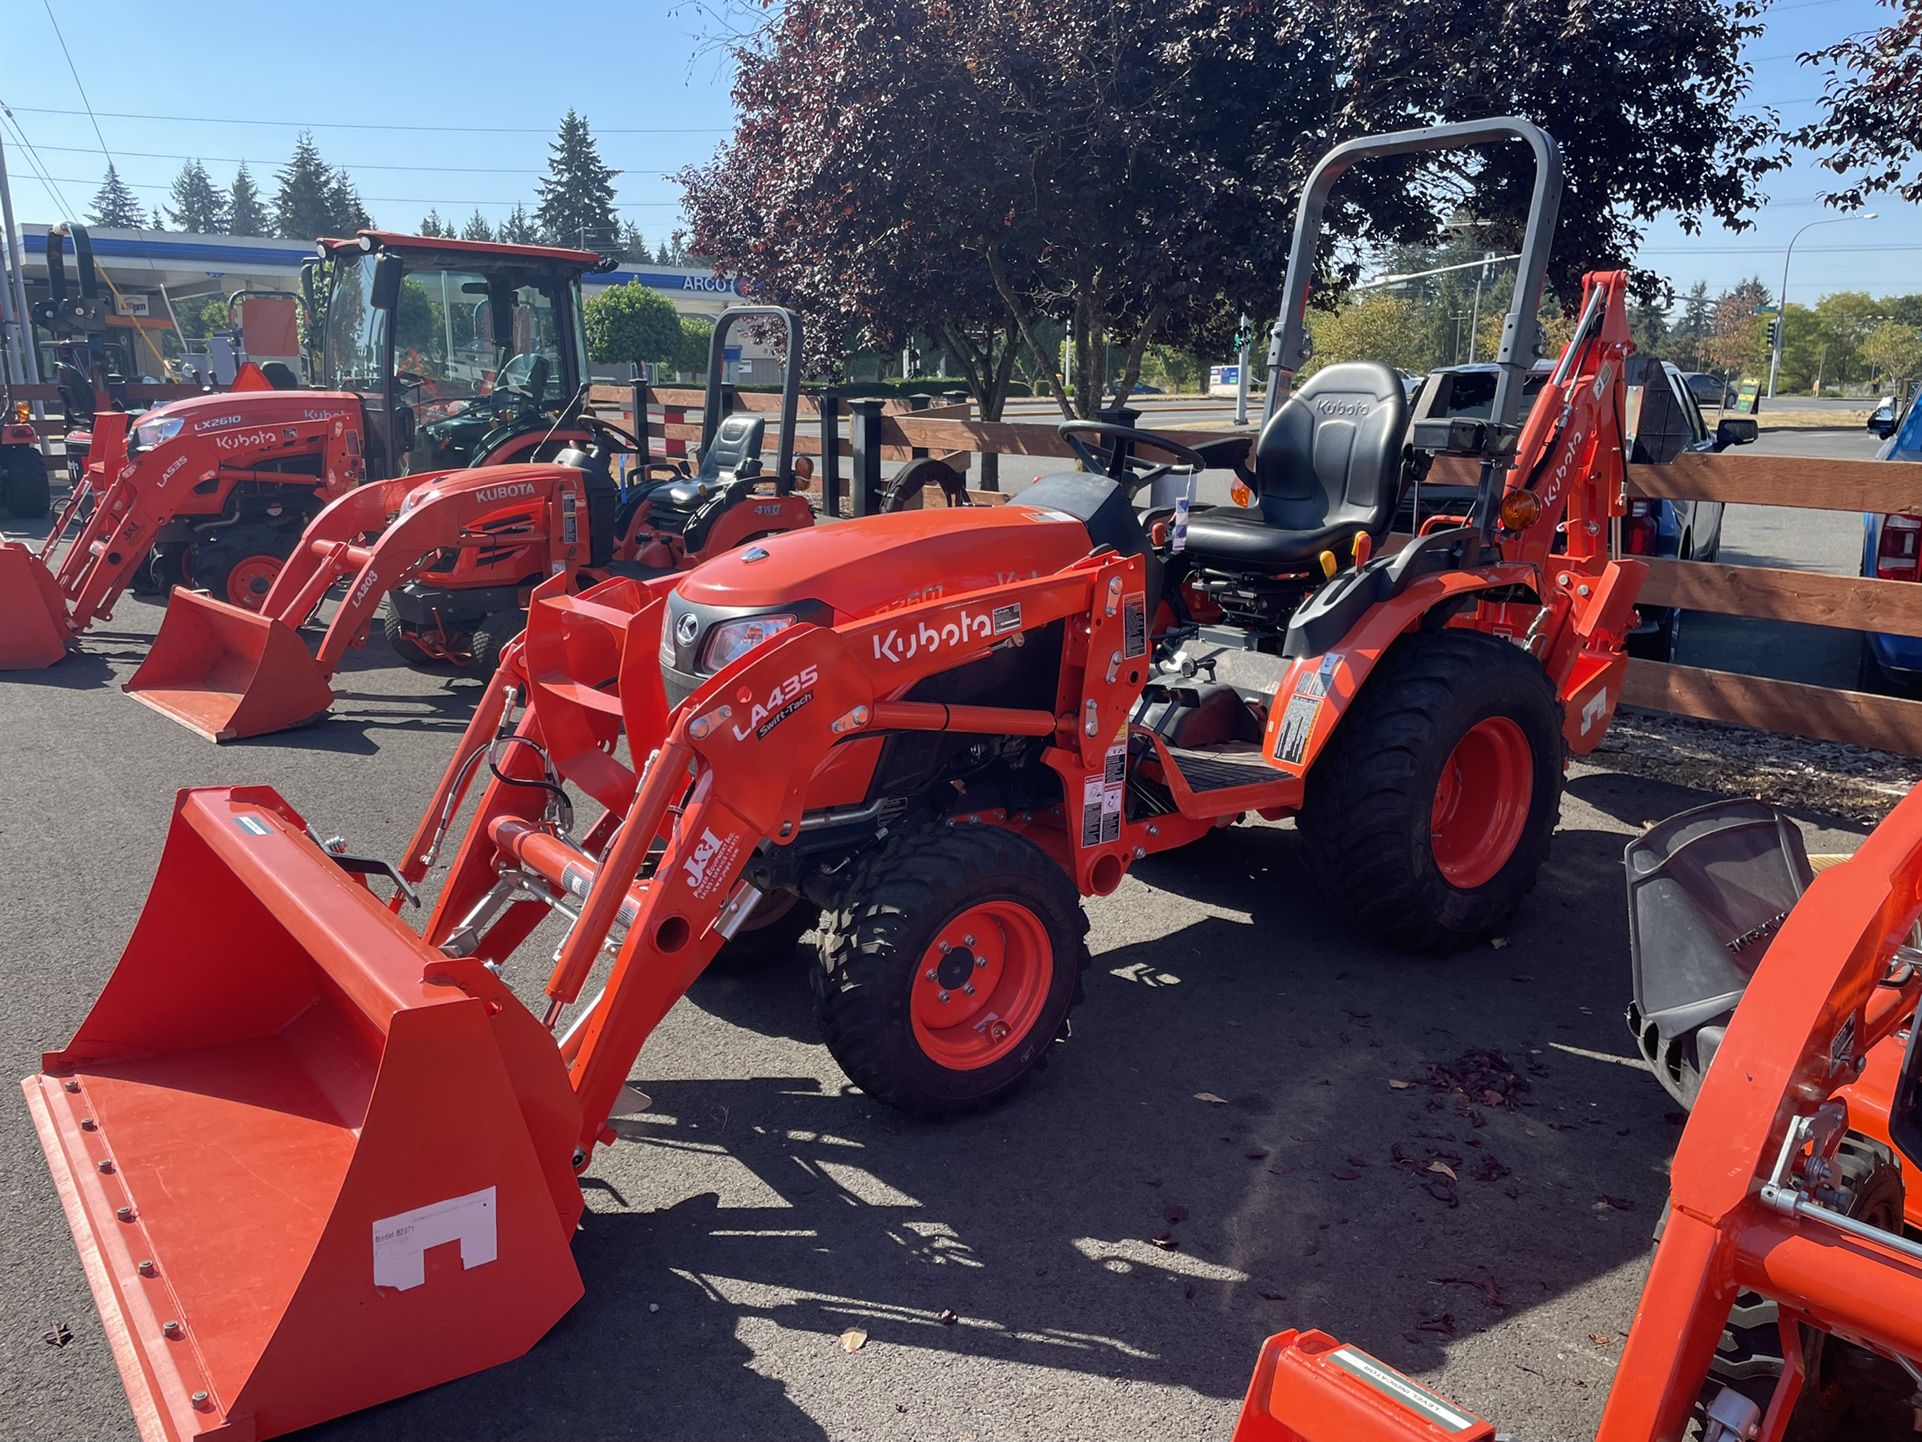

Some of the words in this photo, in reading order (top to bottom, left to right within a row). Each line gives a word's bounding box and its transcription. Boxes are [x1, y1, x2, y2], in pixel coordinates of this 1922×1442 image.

[683, 277, 726, 292] ARCO
[194, 415, 241, 431] LX2610
[1316, 399, 1369, 416] Kubota
[216, 431, 276, 450] Kubota
[157, 454, 188, 488] LA535
[1544, 431, 1582, 507] Kubota
[475, 482, 536, 503] KUBOTA
[754, 504, 781, 516] 4WD
[352, 569, 379, 609] LA203
[872, 610, 992, 663] Kubota
[732, 664, 818, 741] LA435
[759, 693, 812, 737] Swift-Tach
[682, 826, 723, 888] J&I
[1363, 1365, 1411, 1396] INDICATOR
[1412, 1393, 1440, 1411] LEVEL
